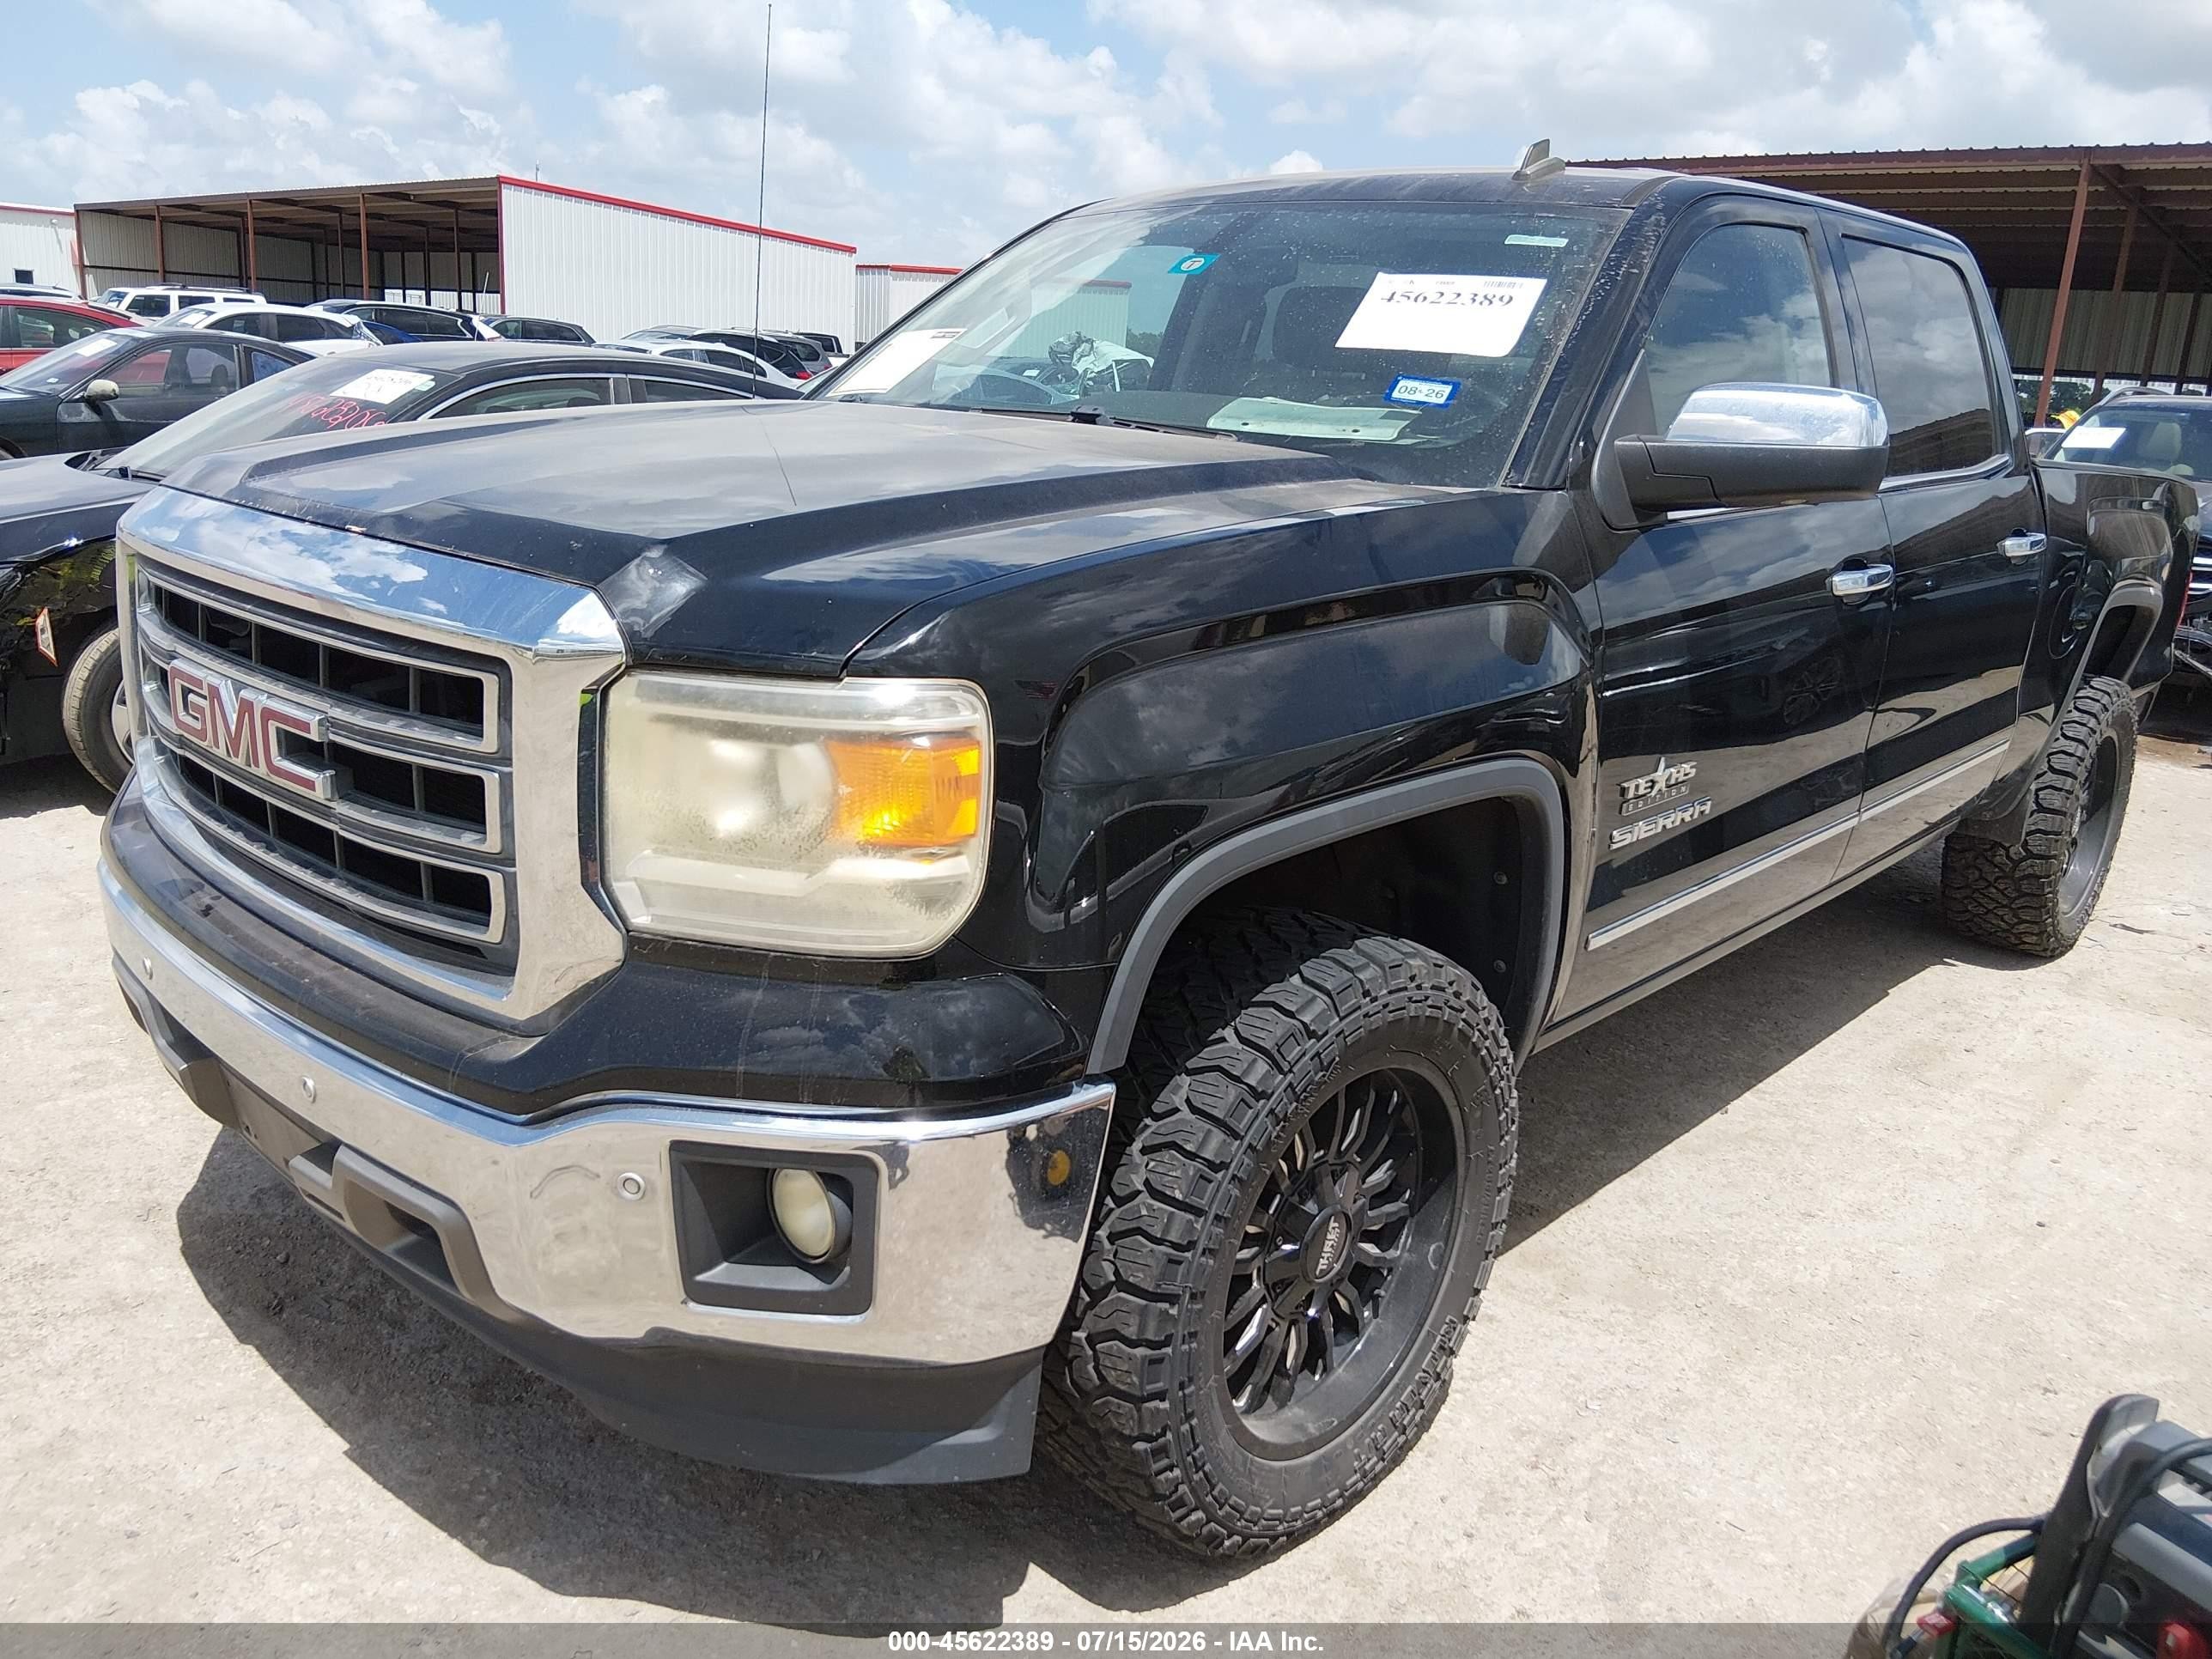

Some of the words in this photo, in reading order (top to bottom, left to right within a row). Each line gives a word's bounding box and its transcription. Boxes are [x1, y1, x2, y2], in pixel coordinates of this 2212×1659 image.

[1381, 291, 1514, 307] 45622389
[1398, 386, 1418, 396] 08
[1425, 388, 1446, 398] 26
[168, 659, 338, 800] GMC
[1619, 757, 1698, 799] TEXAS
[1627, 783, 1687, 811] EDITION
[1608, 796, 1711, 850] SIERRA
